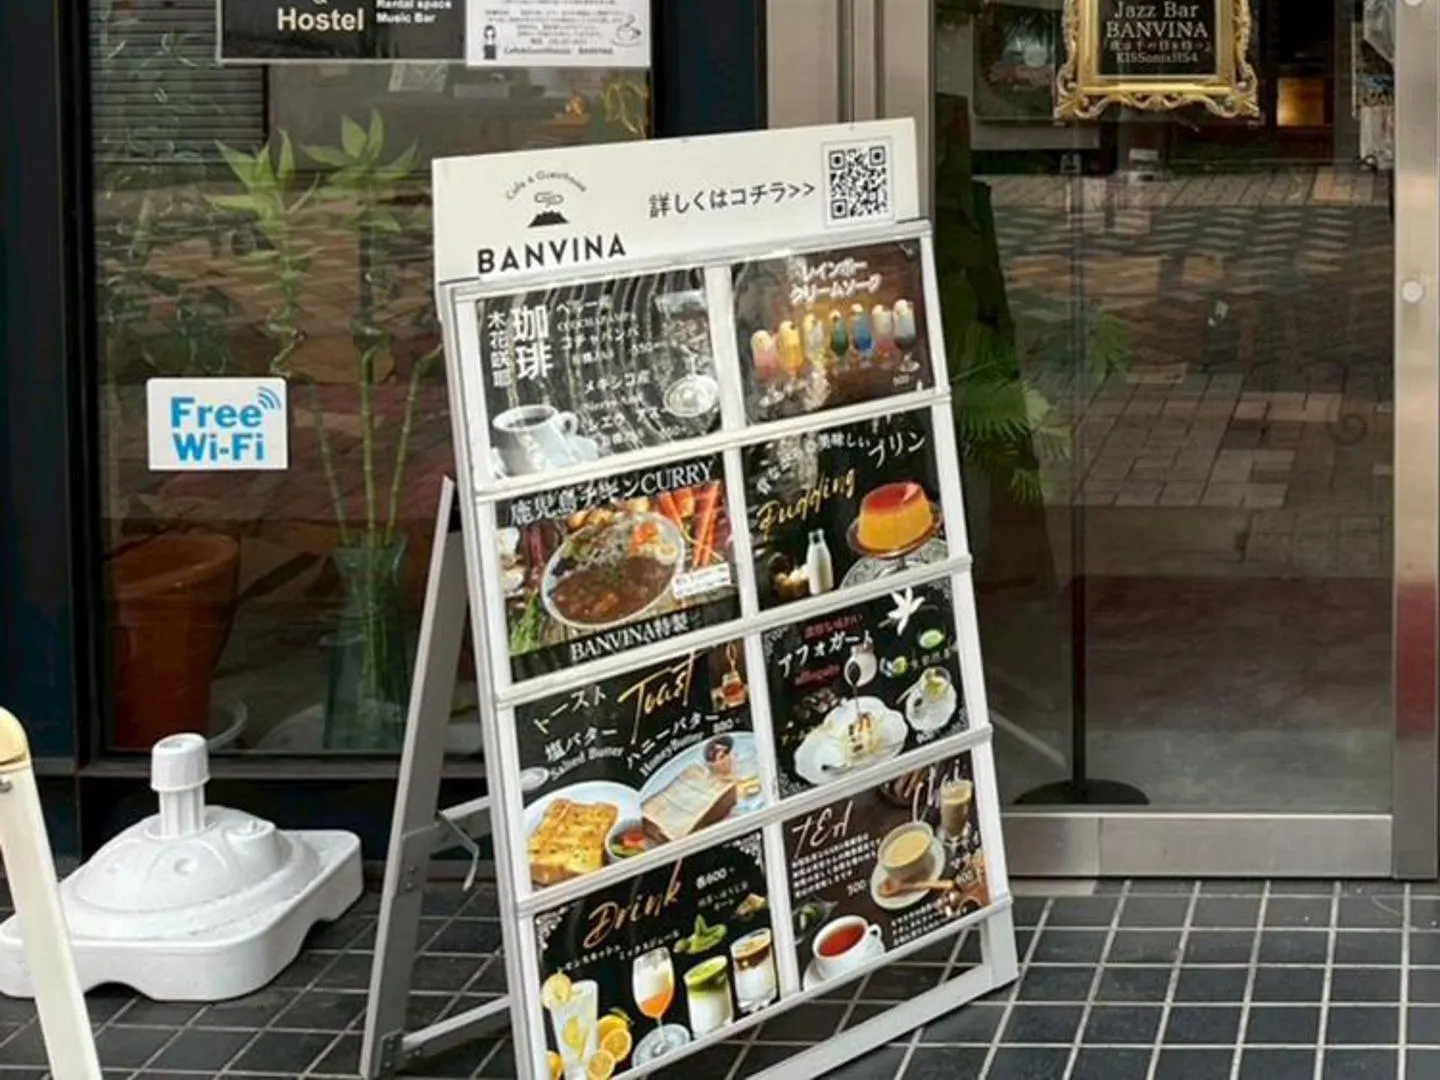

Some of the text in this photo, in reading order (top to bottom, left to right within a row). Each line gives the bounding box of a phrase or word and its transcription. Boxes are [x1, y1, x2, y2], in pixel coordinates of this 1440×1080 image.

[277, 7, 364, 31] Hostel
[375, 0, 452, 11] Rental space
[375, 13, 436, 23] Music Bar
[1114, 1, 1199, 19] Jazz Bar
[1106, 21, 1208, 39] BANVINA
[477, 233, 627, 274] BANVINA
[511, 305, 554, 380] 珈琲
[171, 396, 262, 428] Free
[173, 433, 264, 461] Wi-Fi
[868, 432, 925, 469] プリン
[778, 630, 873, 678] アフォガート
[533, 685, 607, 734] トースト
[544, 724, 618, 762] 塩バター
[626, 712, 720, 770] ハニーバター
[583, 856, 682, 949] Drink
